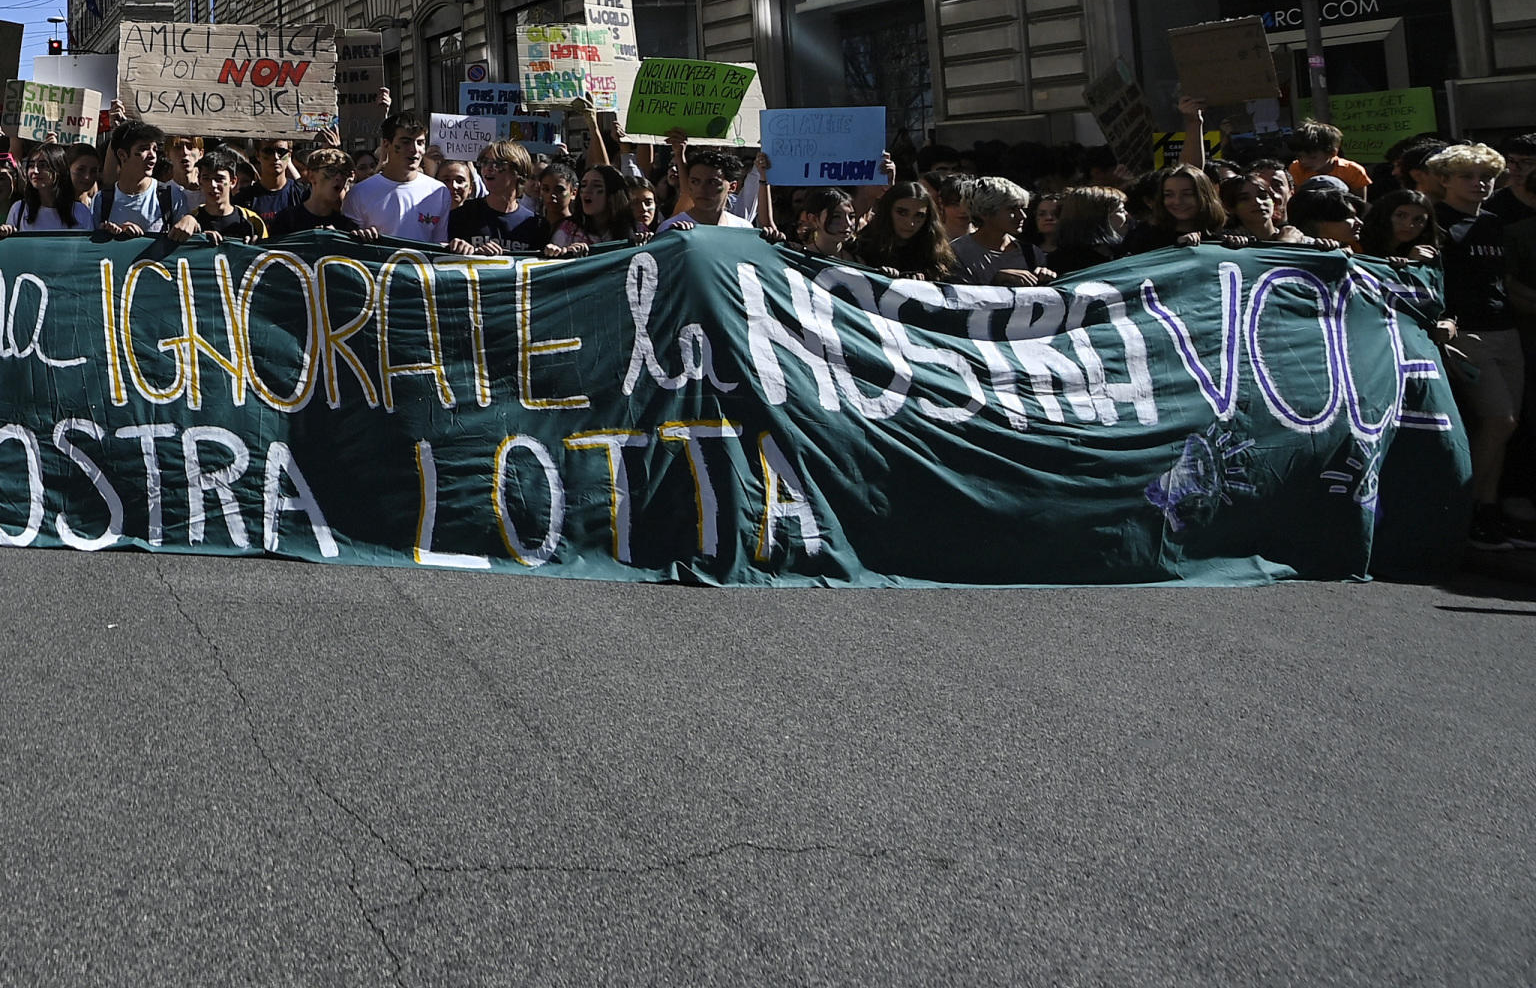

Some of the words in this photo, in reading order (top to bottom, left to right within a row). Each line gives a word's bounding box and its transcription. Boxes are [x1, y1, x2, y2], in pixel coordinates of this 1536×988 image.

[588, 9, 629, 27] WORLD
[124, 24, 211, 55] AMICI
[232, 27, 323, 58] AMICI
[528, 44, 543, 59] IS
[550, 44, 601, 62] HOTTER
[125, 56, 142, 83] E
[160, 56, 198, 80] POI
[217, 58, 312, 88] NON
[643, 64, 664, 79] NOI
[666, 64, 679, 79] IN
[680, 65, 716, 81] PIAZZA
[723, 69, 748, 86] PER
[7, 80, 75, 104] SSTEM
[525, 68, 585, 101] HARRY
[585, 73, 616, 91] STYLES
[693, 83, 706, 97] VOI
[709, 84, 718, 98] A
[135, 90, 226, 116] USANO
[468, 89, 494, 102] THIS
[635, 99, 644, 114] A
[647, 99, 680, 116] FARE
[683, 102, 726, 116] NIENTE!
[67, 115, 93, 129] NOT
[440, 119, 462, 129] NON
[32, 129, 94, 144] CHNGE!
[439, 130, 457, 139] UN
[464, 130, 492, 142] ALTRO
[446, 142, 483, 153] PIANETA
[804, 163, 810, 179] I
[622, 252, 738, 394] la
[736, 261, 1158, 431] NOSTRA
[1143, 261, 1452, 439] VOCE
[413, 418, 825, 570] LOTTA
